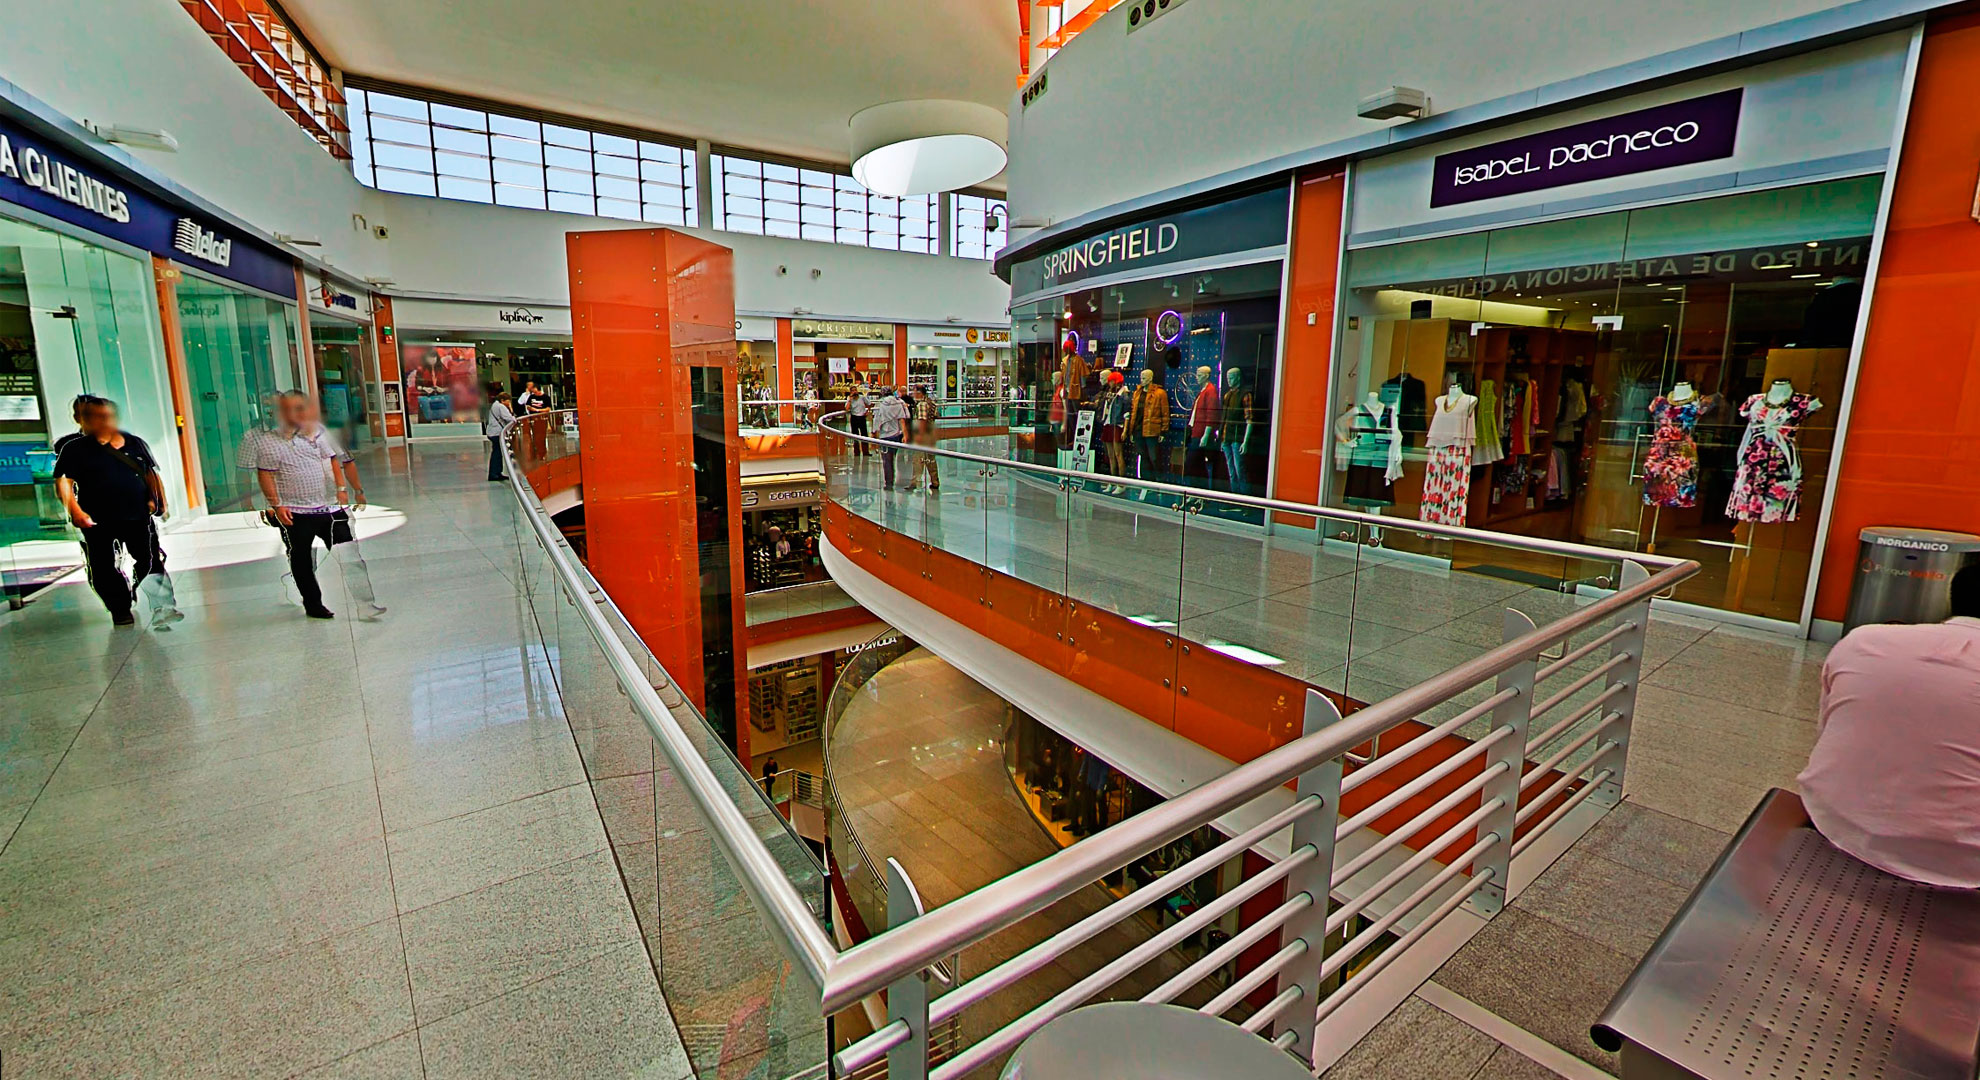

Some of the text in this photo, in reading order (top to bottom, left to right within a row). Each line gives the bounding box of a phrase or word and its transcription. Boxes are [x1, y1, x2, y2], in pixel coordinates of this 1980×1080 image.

[0, 134, 131, 223] A CLIENTES
[194, 224, 232, 267] telcel
[1042, 222, 1179, 280] SPRINGFIELD
[499, 309, 532, 325] kipling
[817, 323, 872, 334] CRISTAL
[1876, 536, 1949, 552] INORGANICO
